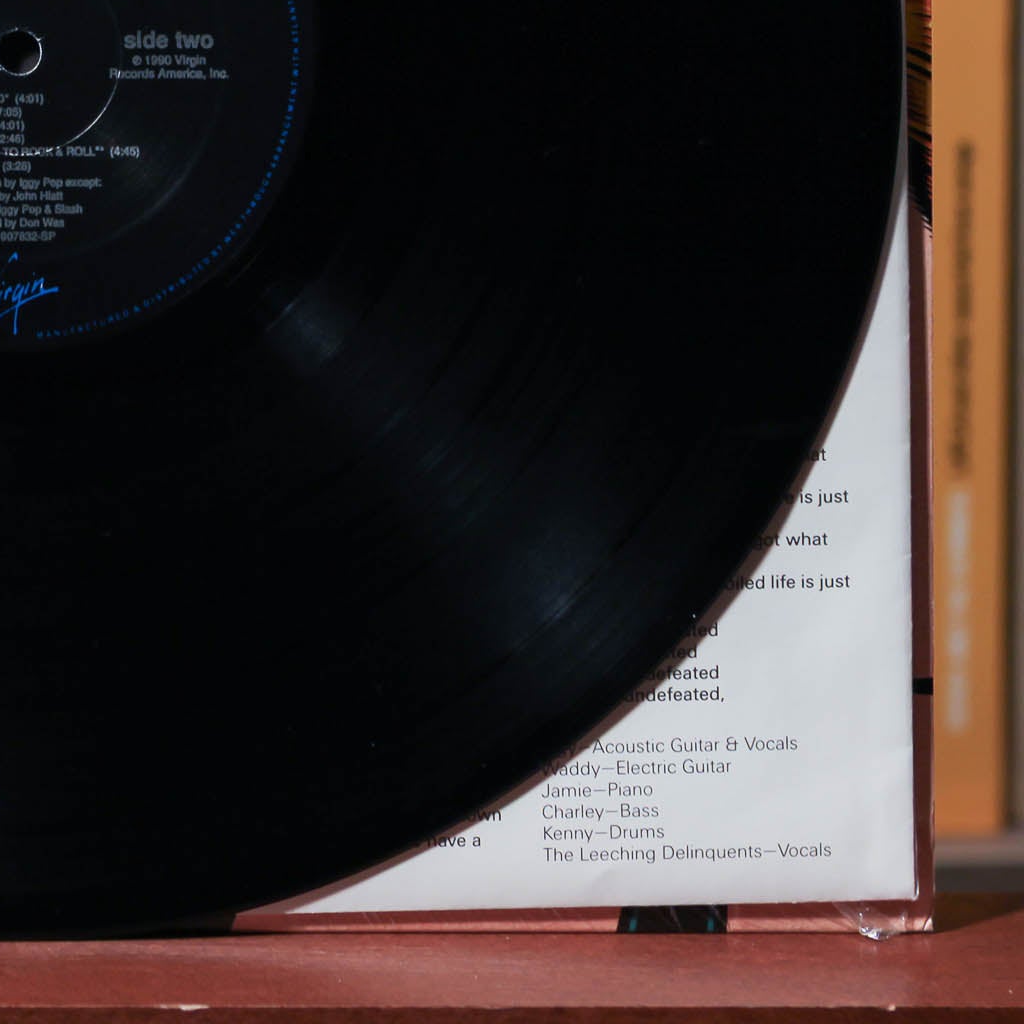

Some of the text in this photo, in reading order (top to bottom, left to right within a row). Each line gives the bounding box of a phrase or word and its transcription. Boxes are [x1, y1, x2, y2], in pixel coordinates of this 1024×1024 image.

[124, 30, 214, 49] side two
[145, 54, 206, 68] 1990 Virgin
[3, 147, 19, 158] TO
[20, 147, 54, 158] ROCK
[55, 146, 63, 157] &
[786, 532, 828, 546] what
[771, 574, 850, 591] life is just
[671, 736, 798, 752] Guitar & Vocals
[544, 847, 573, 862] The
[580, 846, 655, 864] Leeching
